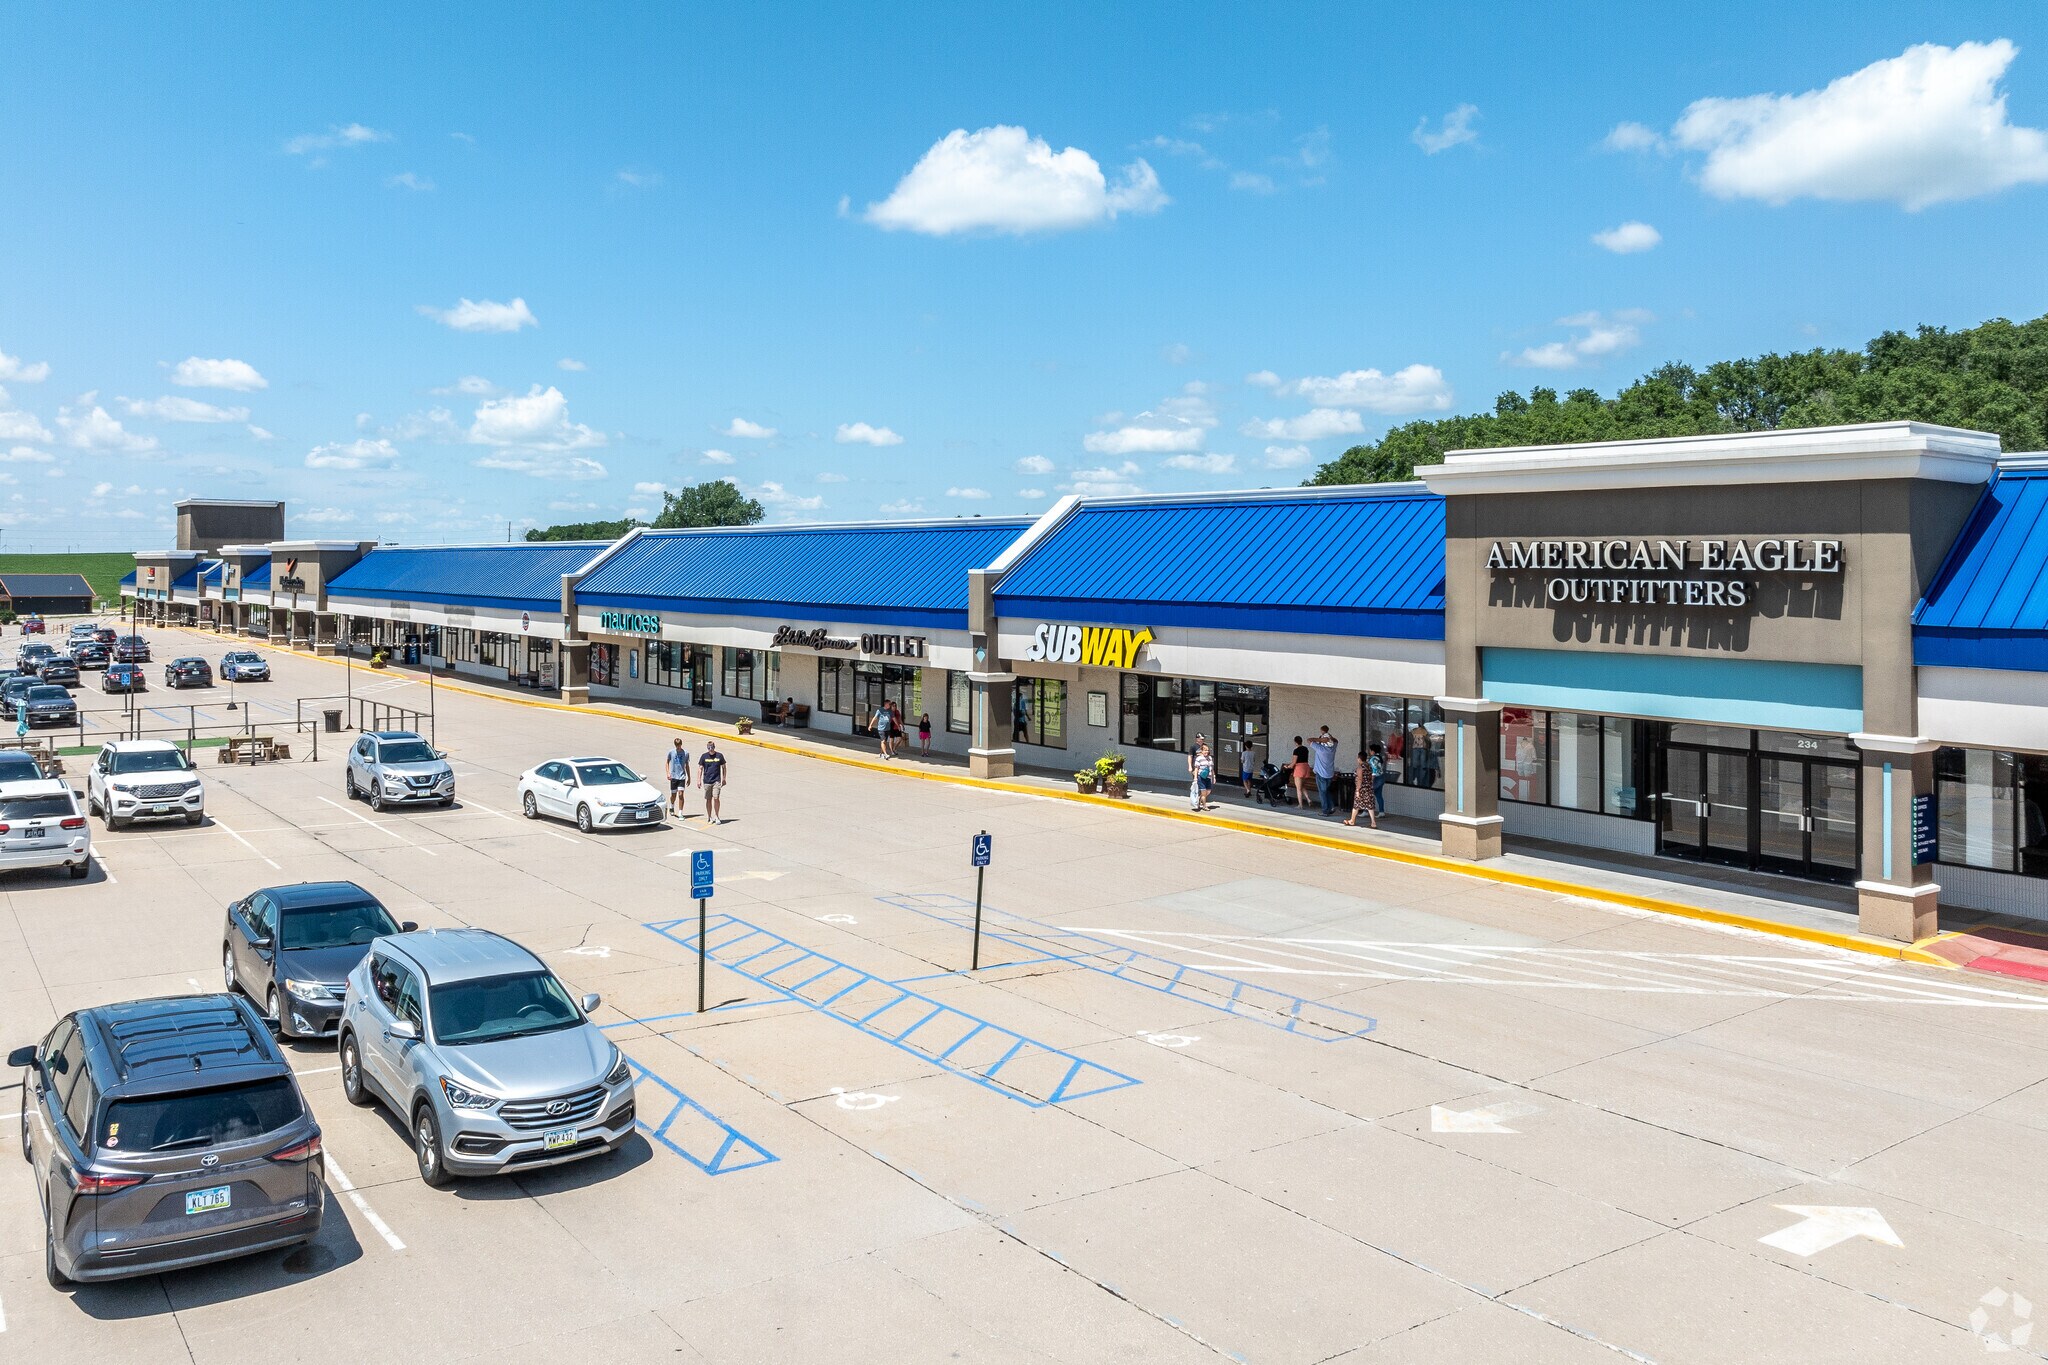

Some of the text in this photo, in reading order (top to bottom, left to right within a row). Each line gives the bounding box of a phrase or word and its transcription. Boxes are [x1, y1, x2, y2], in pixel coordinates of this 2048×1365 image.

[1485, 539, 1840, 572] AMERICAN EAGLE
[1548, 578, 1746, 607] OUTFITTERS
[600, 611, 660, 634] maurices
[861, 633, 926, 658] OUTLET
[1026, 623, 1155, 669] SUBWAY
[1797, 740, 1818, 749] 234
[192, 1196, 208, 1208] KLT
[210, 1192, 225, 1204] 765
